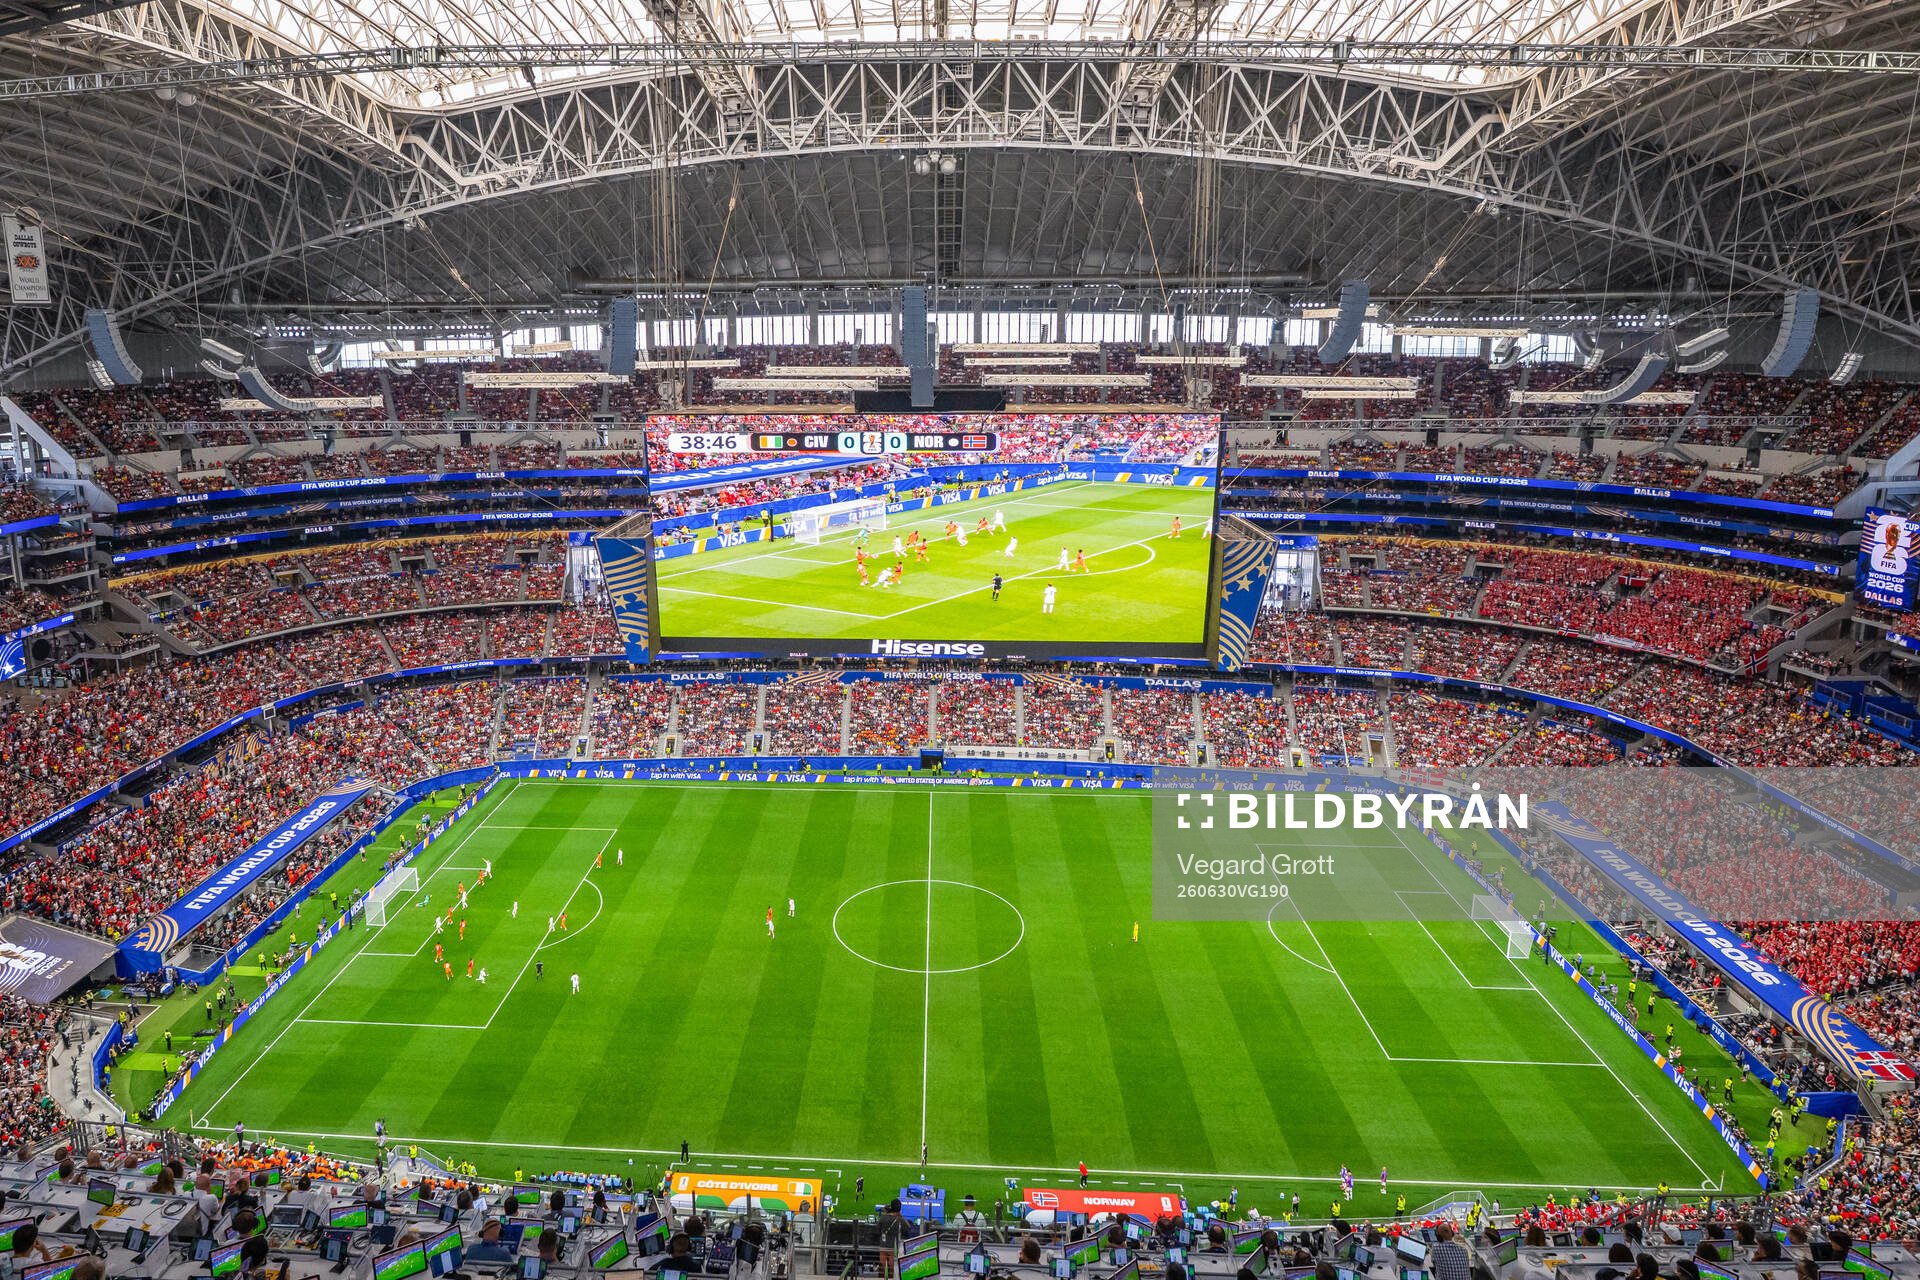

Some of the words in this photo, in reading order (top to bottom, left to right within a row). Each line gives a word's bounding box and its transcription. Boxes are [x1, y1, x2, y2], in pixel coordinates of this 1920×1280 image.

[681, 437, 738, 450] 38:46
[804, 436, 830, 449] CIV
[844, 437, 855, 449] 0
[890, 437, 901, 449] 0
[914, 436, 944, 449] NOR
[1066, 472, 1088, 480] VISA
[1451, 475, 1482, 483] WORLD
[1500, 478, 1529, 486] 2026
[302, 483, 319, 491] FIFA
[321, 481, 344, 490] WORLD
[346, 480, 360, 488] CUP
[361, 478, 386, 486] 2026
[883, 483, 896, 491] FIFA
[986, 484, 1006, 496] VISA
[176, 493, 209, 504] DALLAS
[941, 492, 962, 504] VISA
[1634, 488, 1670, 498] DALLAS
[352, 498, 369, 506] WORLD
[887, 504, 904, 512] VISA
[212, 511, 248, 521] DALLAS
[1680, 516, 1721, 526] DALLAS
[305, 526, 334, 534] DALLAS
[1465, 521, 1496, 529] DALLAS
[1904, 522, 1920, 532] CUP
[718, 532, 747, 548] VISA
[1880, 560, 1898, 570] FIFA
[1868, 572, 1891, 582] WORLD
[1892, 576, 1906, 584] CUP
[1867, 578, 1904, 592] 2026
[1864, 591, 1903, 606] DALLAS
[872, 640, 985, 656] Hisense
[671, 672, 725, 681] DALLAS
[1145, 678, 1202, 688] DALLAS
[546, 770, 567, 778] VISA
[594, 770, 614, 778] VISA
[650, 772, 662, 780] tap
[738, 773, 758, 782] VISA
[785, 774, 806, 782] VISA
[1030, 779, 1052, 787] VISA
[1080, 780, 1102, 788] VISA
[1232, 782, 1254, 791] VISA
[1284, 784, 1306, 792] VISA
[458, 806, 468, 818] VISA
[1800, 805, 1810, 815] FIFA
[1810, 810, 1828, 825] WORLD
[1828, 820, 1838, 830] CUP
[20, 830, 32, 840] FIFA
[32, 821, 49, 834] WORLD
[49, 816, 58, 824] CUP
[434, 825, 445, 838] VISA
[1434, 834, 1444, 850] VISA
[184, 884, 224, 910] FIFA
[217, 848, 274, 890] WORLD
[270, 828, 297, 850] CUP
[291, 801, 338, 832] 2026
[1594, 849, 1631, 872] FIFA
[1623, 871, 1683, 914] WORLD
[1674, 911, 1716, 938] CUP
[1705, 936, 1780, 986] 2026
[318, 928, 332, 948] VISA
[236, 940, 248, 953] FIFA
[1549, 947, 1565, 970] VISA
[34, 958, 62, 976] 2026
[248, 1002, 259, 1016] tap
[258, 996, 265, 1006] in
[265, 982, 278, 1001] with
[278, 970, 292, 987] VISA
[1594, 992, 1606, 1010] tap
[1604, 1001, 1611, 1014] in
[1610, 1008, 1626, 1028] with
[1624, 1023, 1638, 1042] VISA
[1712, 1023, 1726, 1040] FIFA
[198, 1043, 216, 1068] VISA
[1672, 1070, 1695, 1100] VISA
[155, 1092, 174, 1120] VISA
[1720, 1124, 1741, 1156] VISA
[697, 1180, 728, 1189] CÔTE
[730, 1180, 778, 1192] D'IVOIRE
[1084, 1196, 1136, 1207] NORWAY
